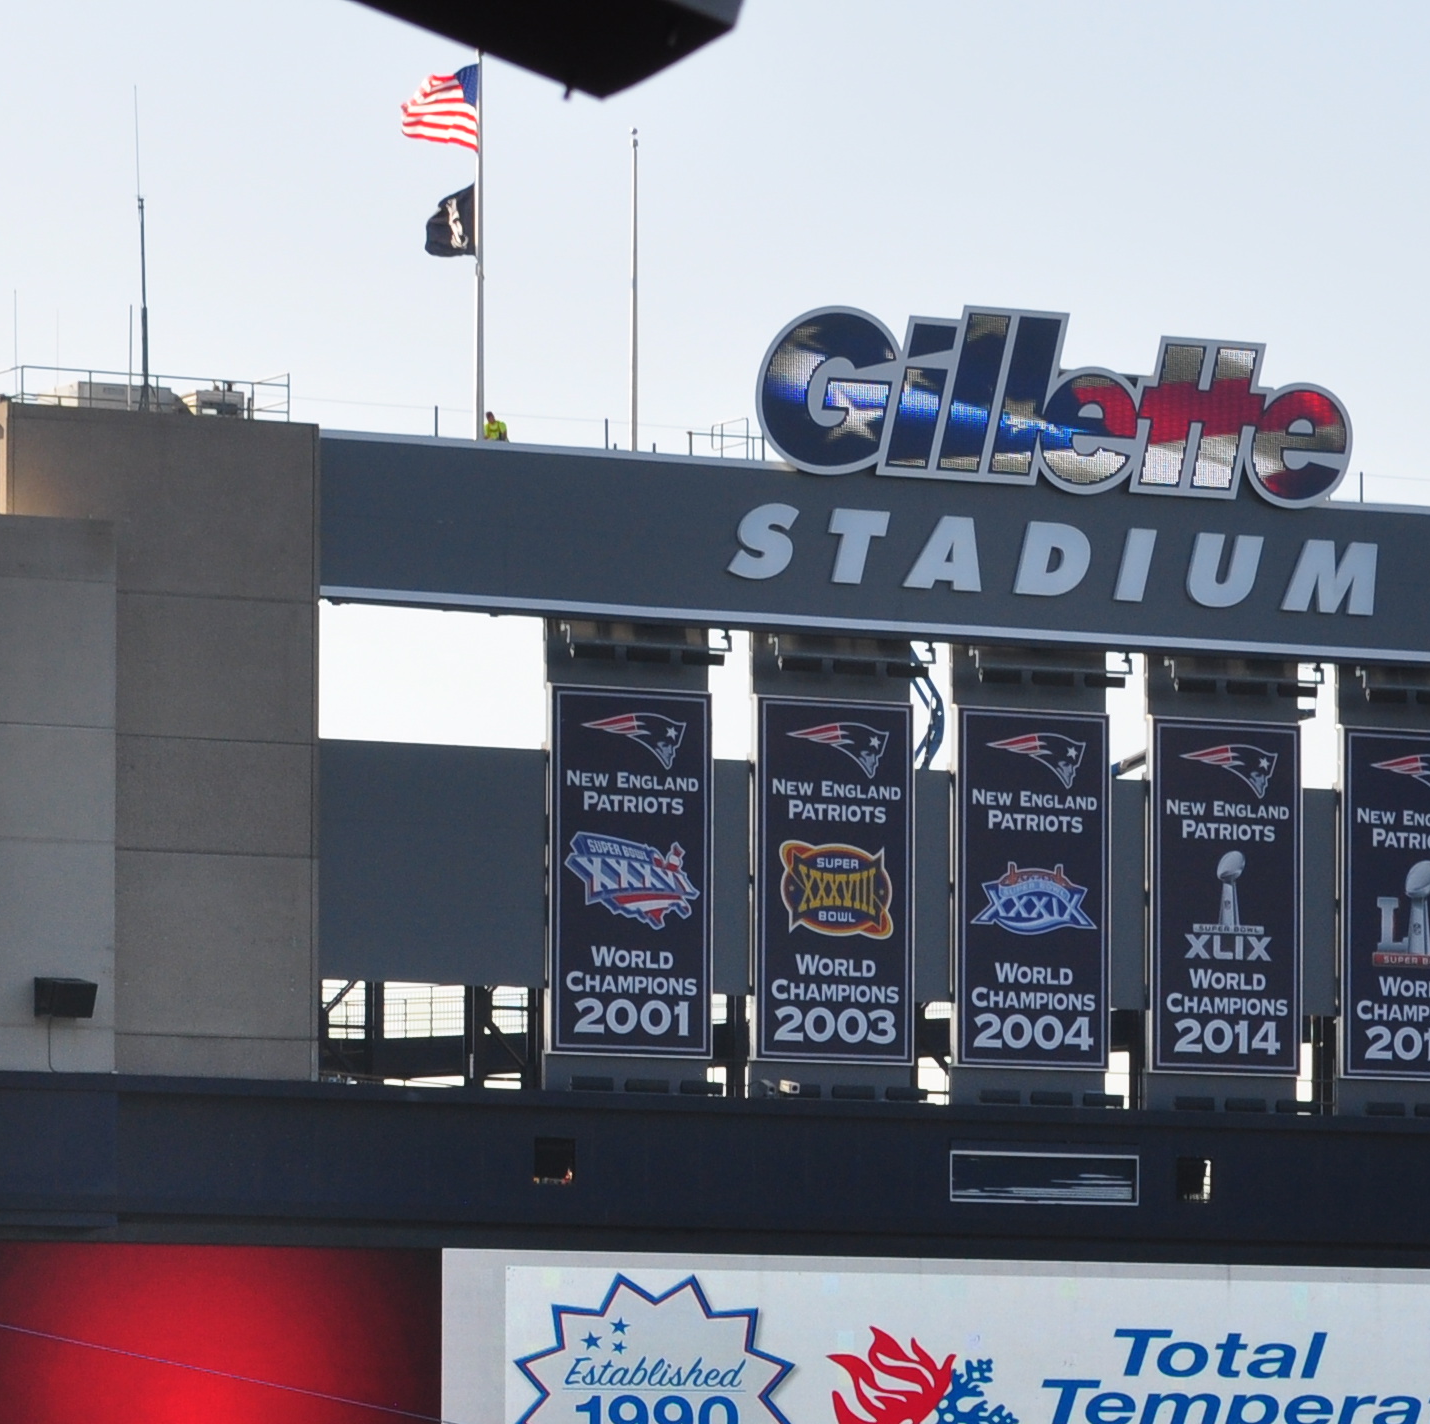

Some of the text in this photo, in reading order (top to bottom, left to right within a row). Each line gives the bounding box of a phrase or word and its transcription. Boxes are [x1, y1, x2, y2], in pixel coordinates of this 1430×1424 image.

[756, 305, 1353, 509] Gillette
[727, 502, 1379, 616] STADIUM
[567, 770, 699, 792] NEW ENGLAND
[772, 778, 901, 802] NEW ENGLAND
[583, 791, 684, 815] PATRIOTS
[788, 799, 887, 824] PATRIOTS
[972, 789, 1097, 811] NEW ENGLAND
[1166, 798, 1289, 820] NEW ENGLAND
[988, 810, 1083, 833] PATRIOTS
[1357, 807, 1396, 825] NEW
[1182, 819, 1275, 843] PATRIOTS
[587, 839, 650, 861] SUPER BOWL
[816, 857, 859, 869] SUPER
[818, 911, 856, 922] BOWL
[591, 945, 674, 970] WORLD
[1184, 933, 1272, 962] XLIX
[1383, 955, 1418, 964] SUPER
[795, 954, 876, 978] WORLD
[995, 961, 1073, 985] WORLD
[566, 970, 697, 996] CHAMPIONS
[771, 978, 899, 1003] CHAMPIONS
[1189, 967, 1266, 991] WORLD
[971, 986, 1095, 1011] CHAMPIONS
[1166, 992, 1288, 1017] CHAMPIONS
[574, 998, 690, 1036] 2001
[773, 1006, 896, 1045] 2003
[973, 1012, 1094, 1051] 2004
[1174, 1018, 1281, 1055] 2014
[1112, 1328, 1327, 1380] Total
[564, 1357, 746, 1388] Established
